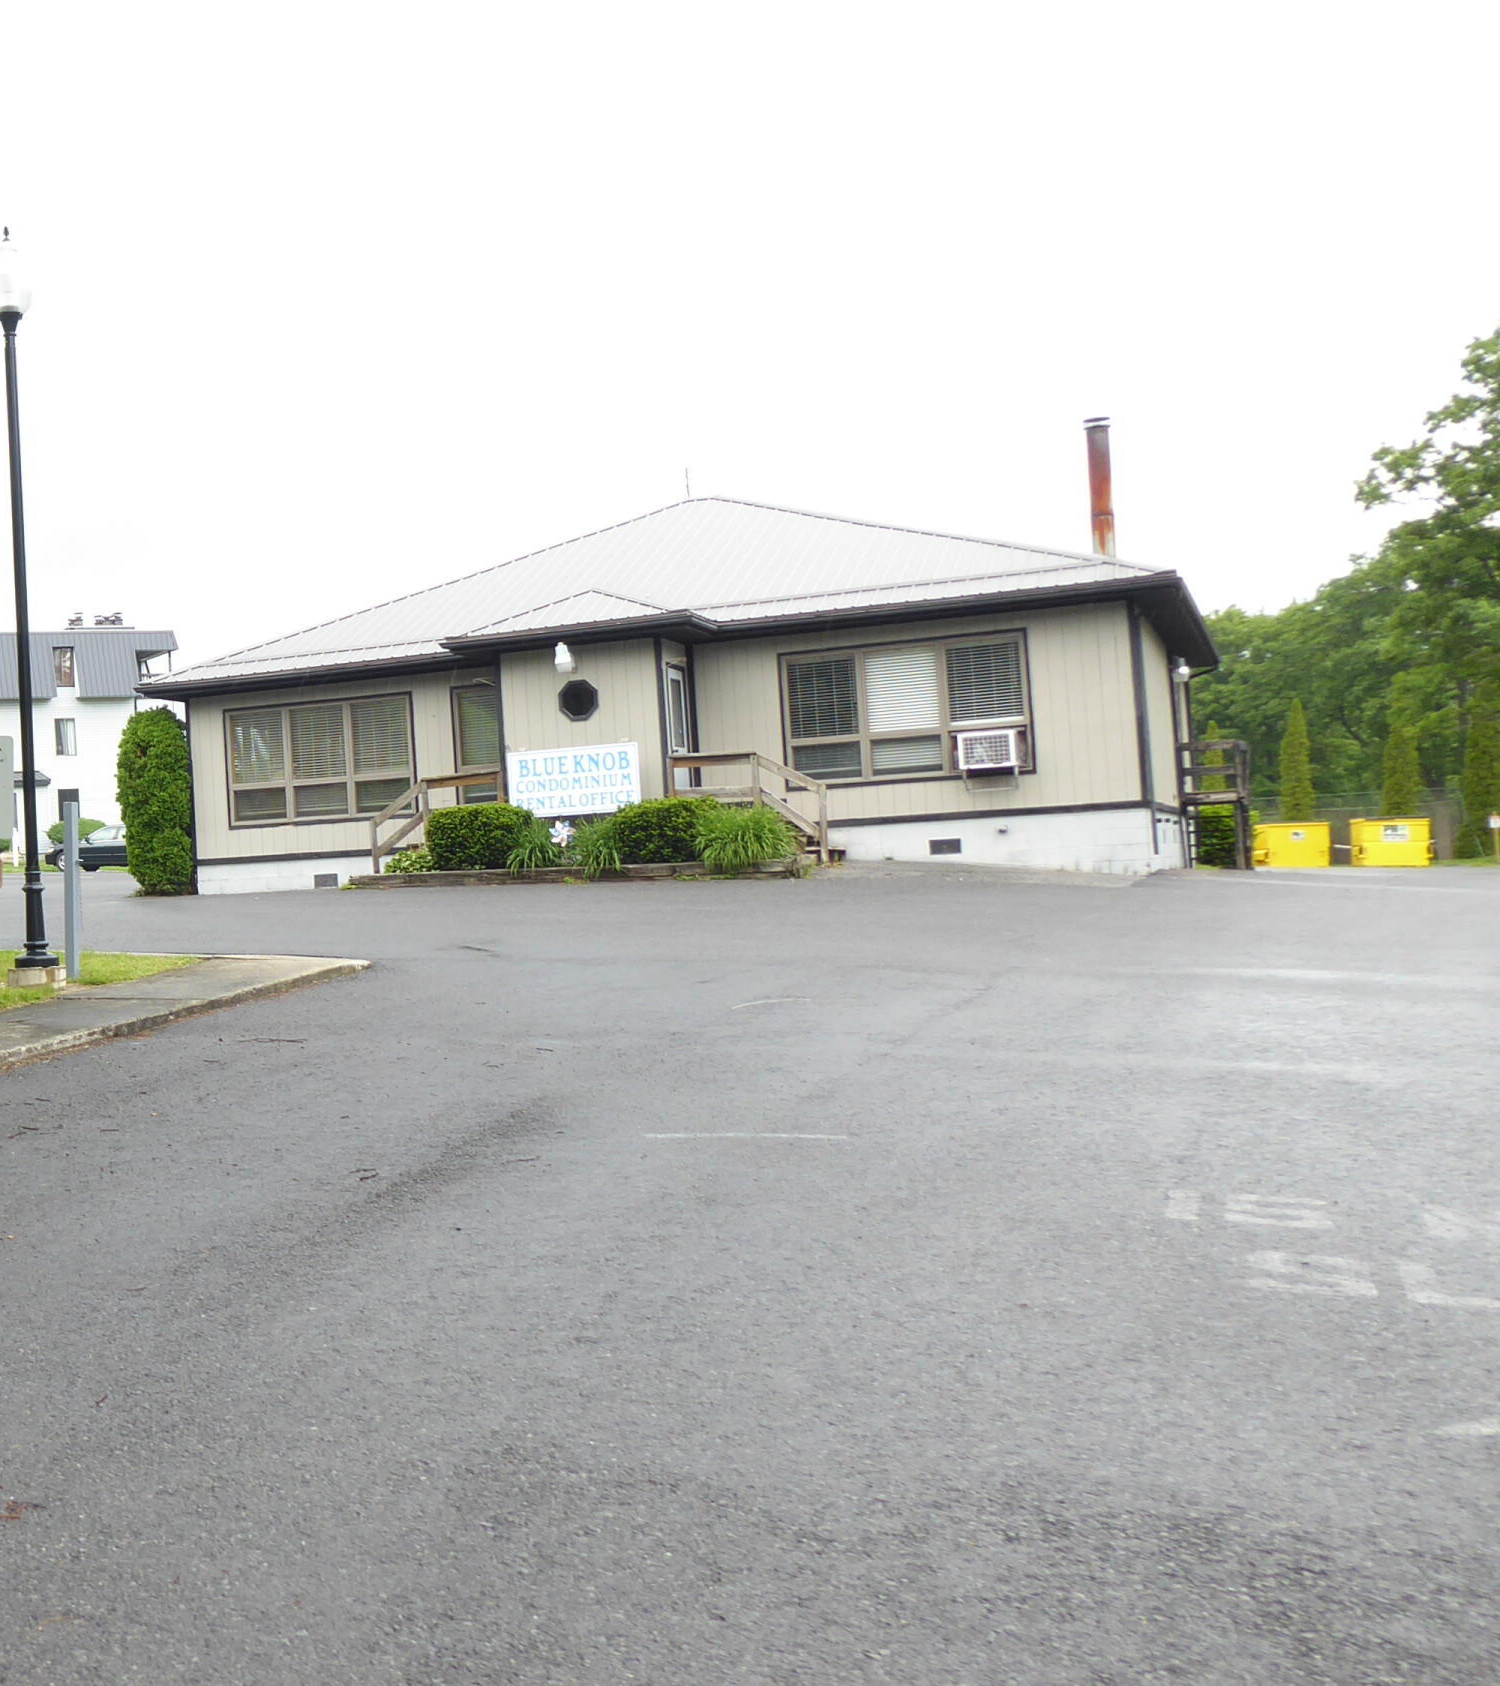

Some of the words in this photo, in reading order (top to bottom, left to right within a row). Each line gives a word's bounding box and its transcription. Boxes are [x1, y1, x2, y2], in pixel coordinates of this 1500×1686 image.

[517, 755, 569, 778] BLUE
[572, 751, 630, 774] KNOB
[515, 773, 632, 794] CONDOMINIUM
[515, 795, 577, 811] RENTAL
[579, 790, 634, 807] OFFICE
